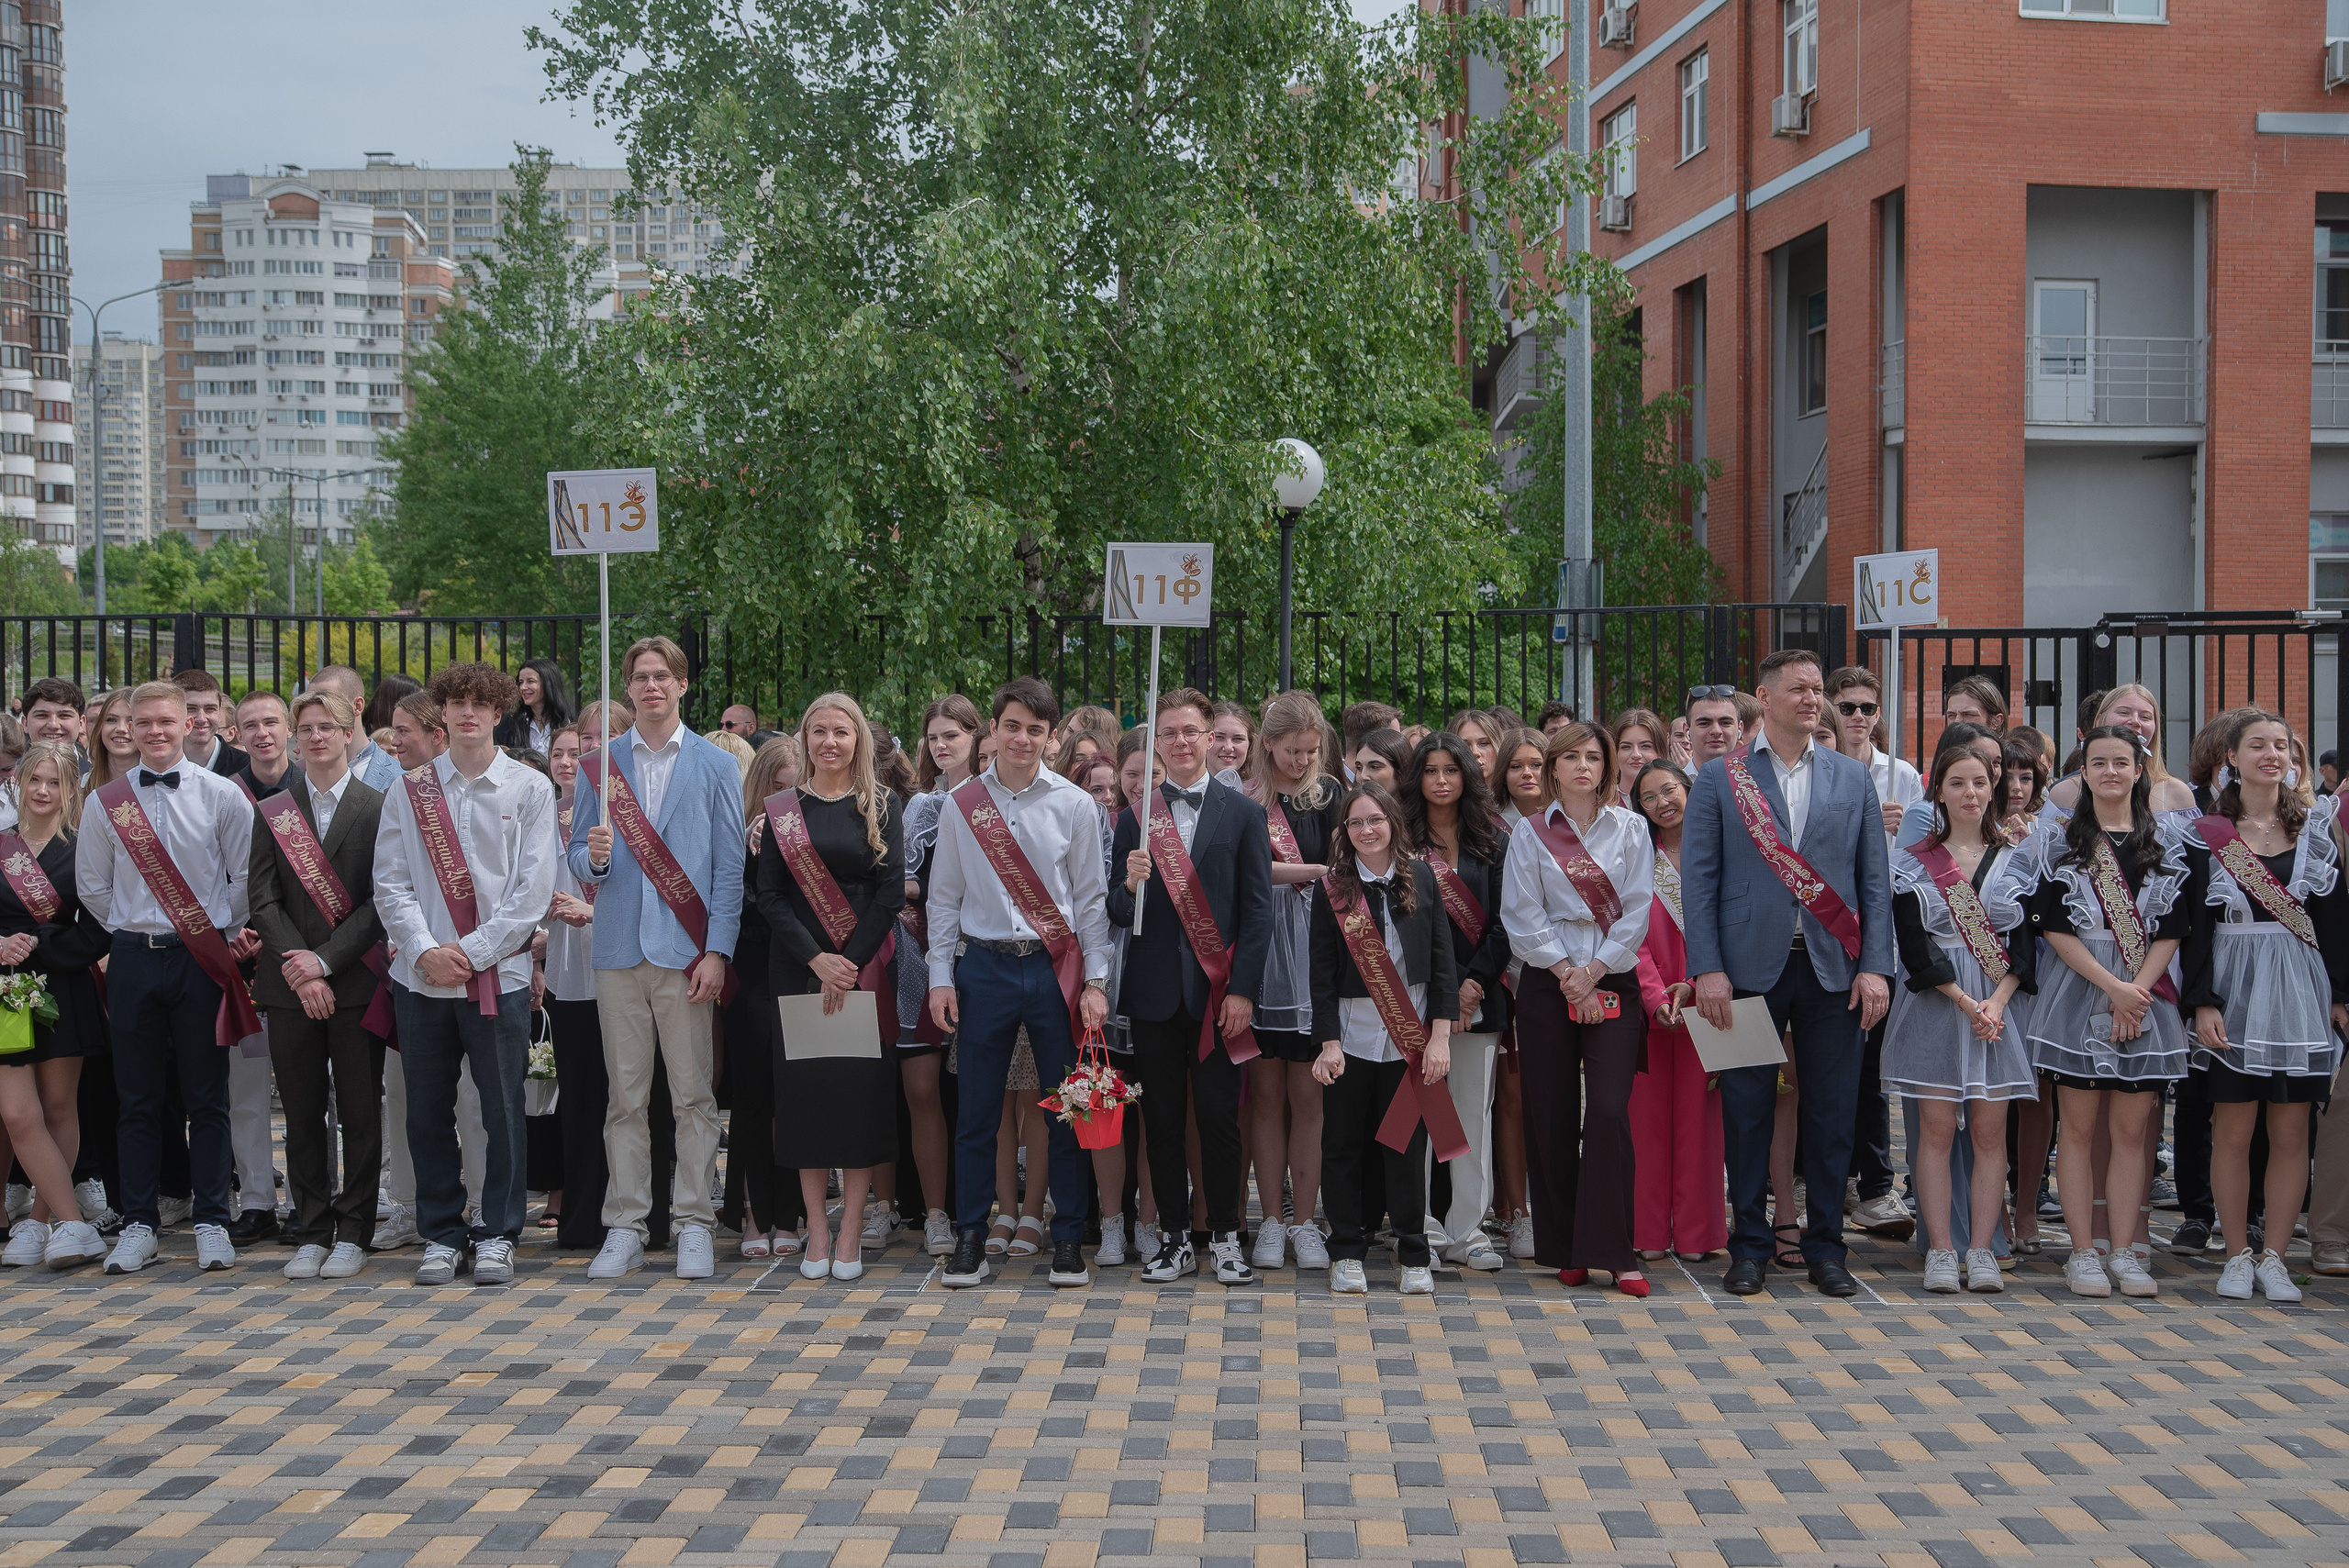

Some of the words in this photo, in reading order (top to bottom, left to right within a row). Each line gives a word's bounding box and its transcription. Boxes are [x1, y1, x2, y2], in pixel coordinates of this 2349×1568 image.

[577, 501, 646, 532] 11Э
[1133, 574, 1201, 605] 11Ф
[1876, 577, 1932, 607] 11С
[128, 826, 184, 908] Выпускник
[177, 902, 213, 935] 2023
[290, 834, 342, 914] Выпускник
[417, 784, 454, 869] Выпускник
[446, 867, 474, 900] 2023
[617, 800, 669, 877] Выпускник
[662, 870, 697, 904] 2023
[986, 828, 1041, 910] Выпускник
[1031, 904, 1071, 940] 2023
[1749, 822, 1810, 881] руководитель
[1160, 837, 1201, 918] Выпускник
[1192, 917, 1224, 955] 2023
[1360, 939, 1407, 1024] Выпускница
